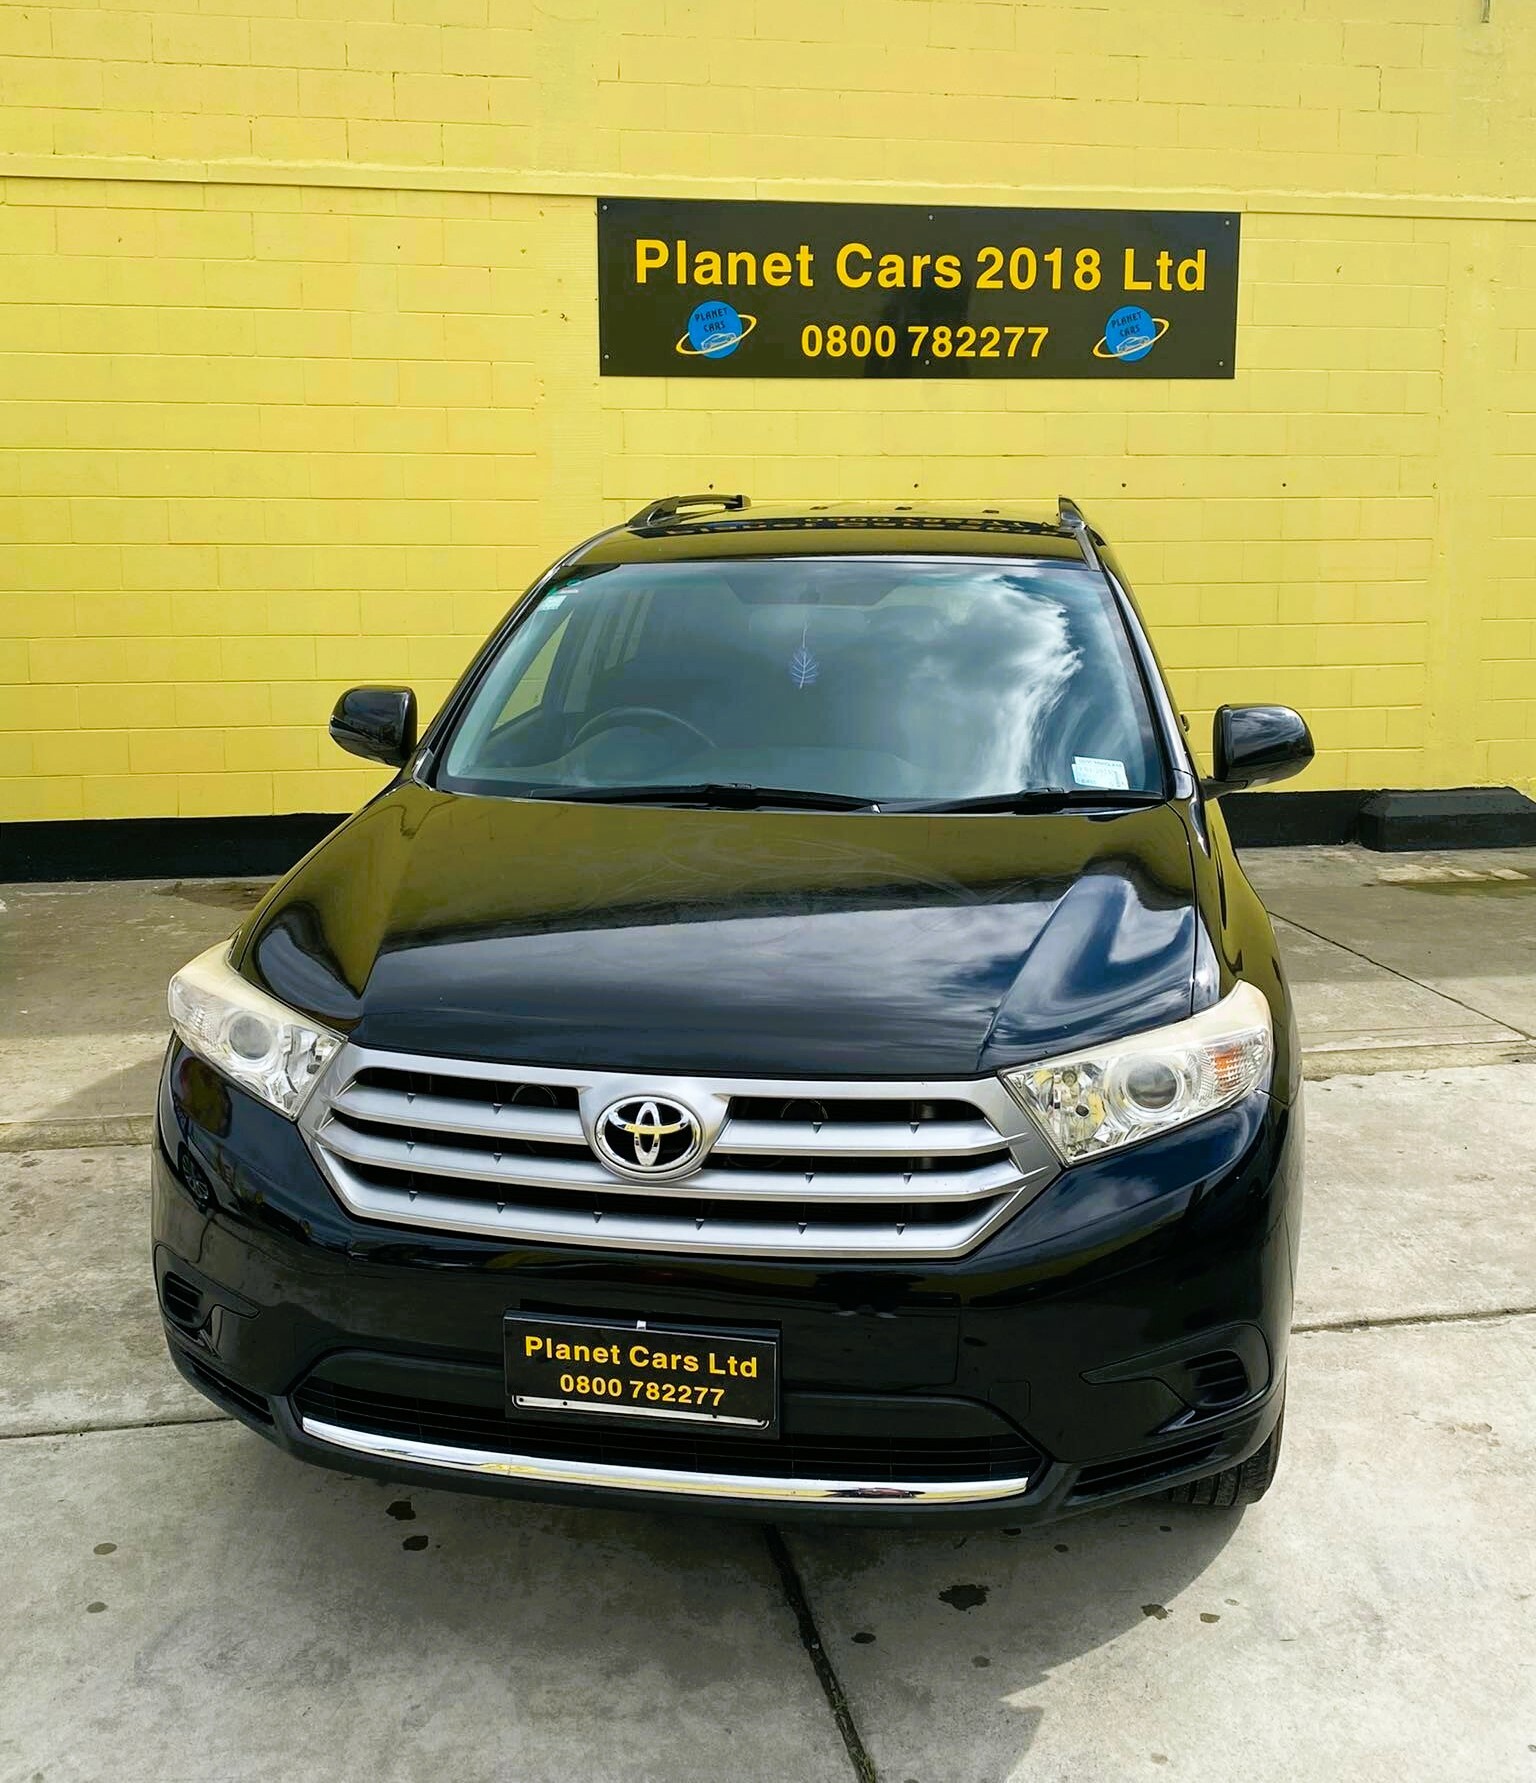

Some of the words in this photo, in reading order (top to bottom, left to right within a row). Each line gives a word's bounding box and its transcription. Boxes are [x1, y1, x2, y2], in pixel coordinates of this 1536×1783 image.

[635, 238, 814, 287] Planet
[835, 242, 962, 289] Cars
[975, 246, 1102, 292] 2018
[1123, 247, 1206, 292] Ltd
[694, 307, 728, 321] PLANET
[703, 320, 726, 332] CARS
[1111, 311, 1142, 328] PLANET
[801, 324, 896, 358] 0800
[907, 325, 1049, 358] 782277
[1119, 324, 1140, 337] CARS
[525, 1335, 620, 1365] Planet
[629, 1345, 699, 1372] Cars
[709, 1353, 757, 1378] Ltd
[560, 1373, 622, 1397] 0800
[629, 1380, 725, 1406] 782277
